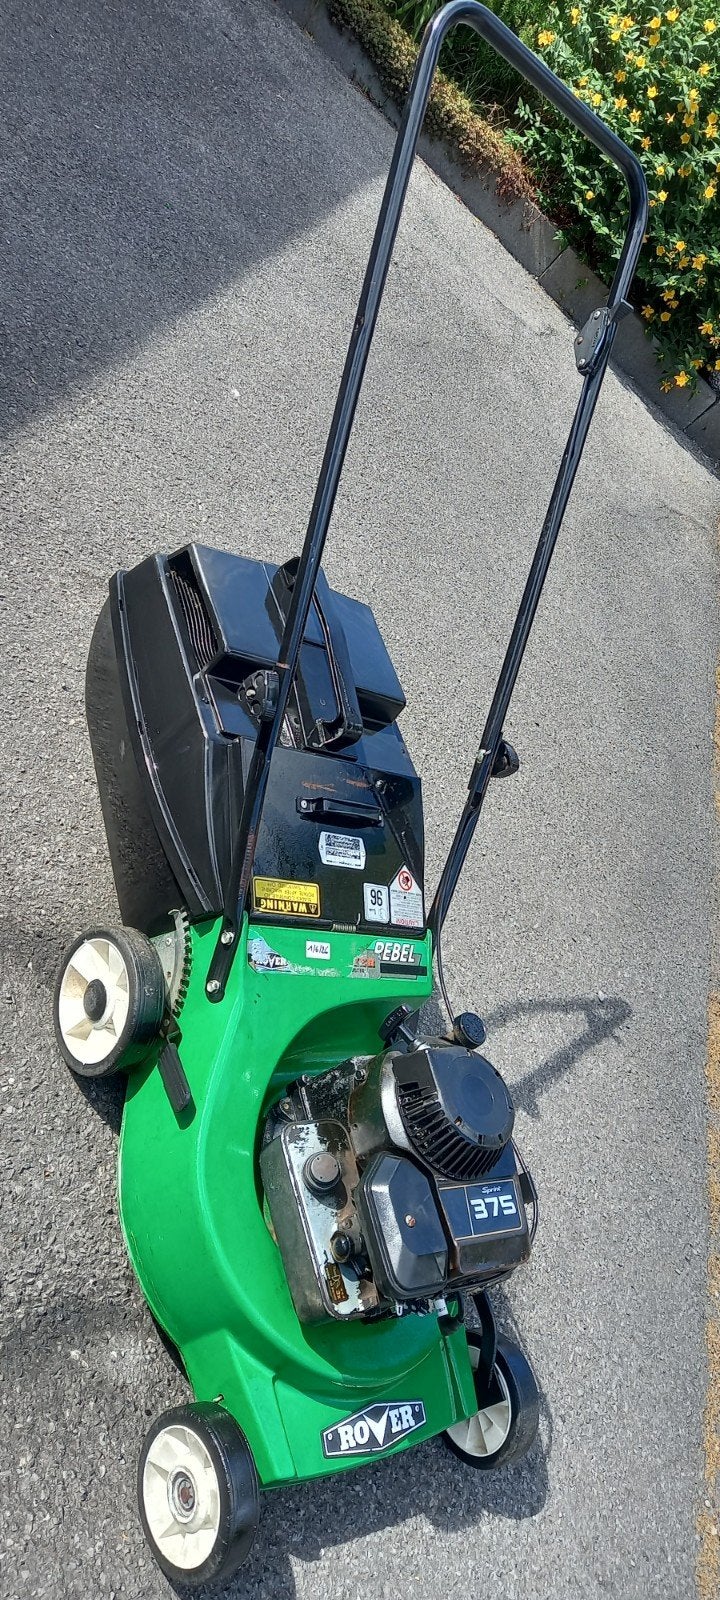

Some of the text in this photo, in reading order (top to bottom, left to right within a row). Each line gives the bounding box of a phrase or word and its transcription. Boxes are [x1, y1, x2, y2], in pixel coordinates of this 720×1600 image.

[260, 898, 308, 913] WARNING
[370, 889, 383, 907] 96
[481, 1185, 502, 1195] Sprint
[470, 1194, 517, 1220] 375
[337, 1404, 416, 1451] ROVER
